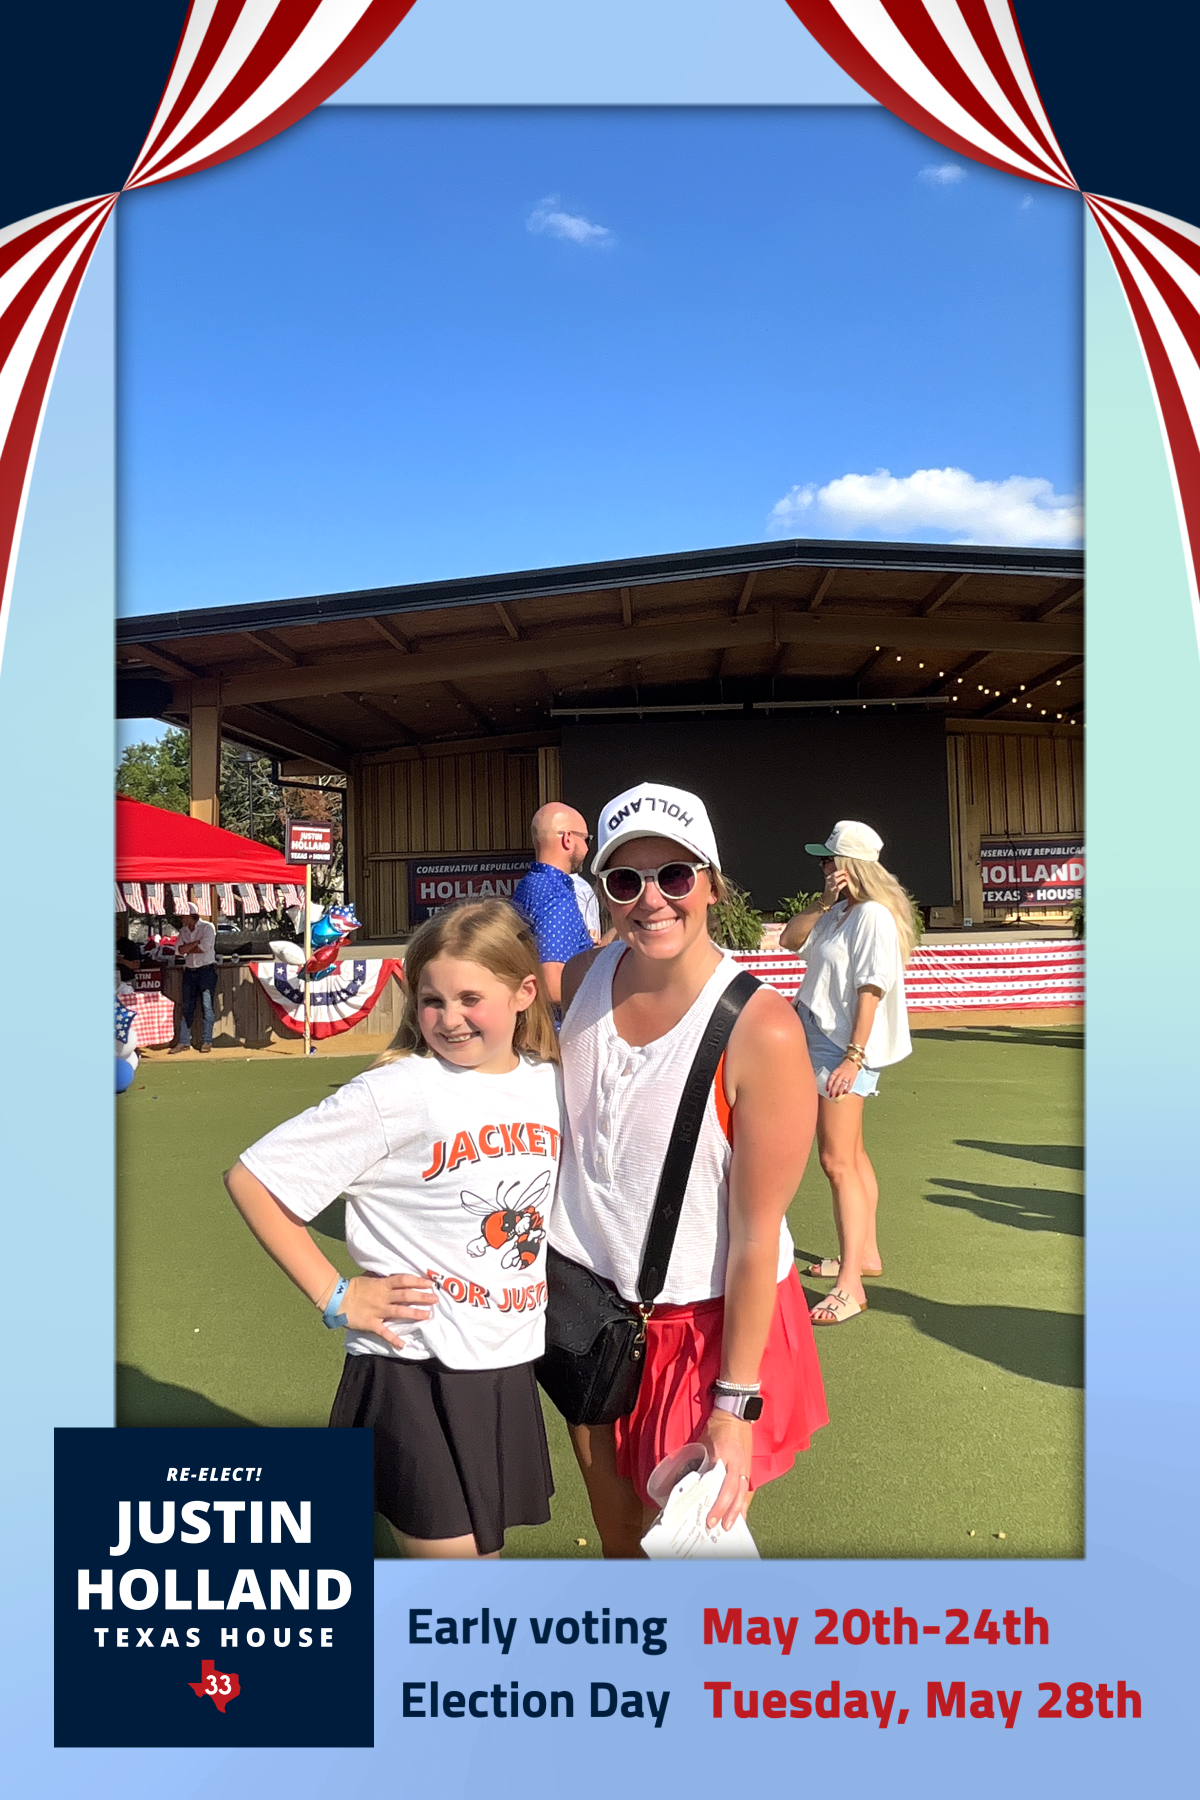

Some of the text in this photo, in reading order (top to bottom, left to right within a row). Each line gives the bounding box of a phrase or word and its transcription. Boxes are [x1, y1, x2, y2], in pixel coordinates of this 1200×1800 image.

[608, 797, 694, 831] HOLLAND
[300, 832, 323, 841] JUSTIN
[291, 840, 331, 851] HOLLAND
[981, 848, 1032, 858] NSERVATIVE
[416, 864, 478, 874] CONSERVATIVE
[1037, 888, 1082, 900] HOUSE
[136, 980, 161, 989] LAND
